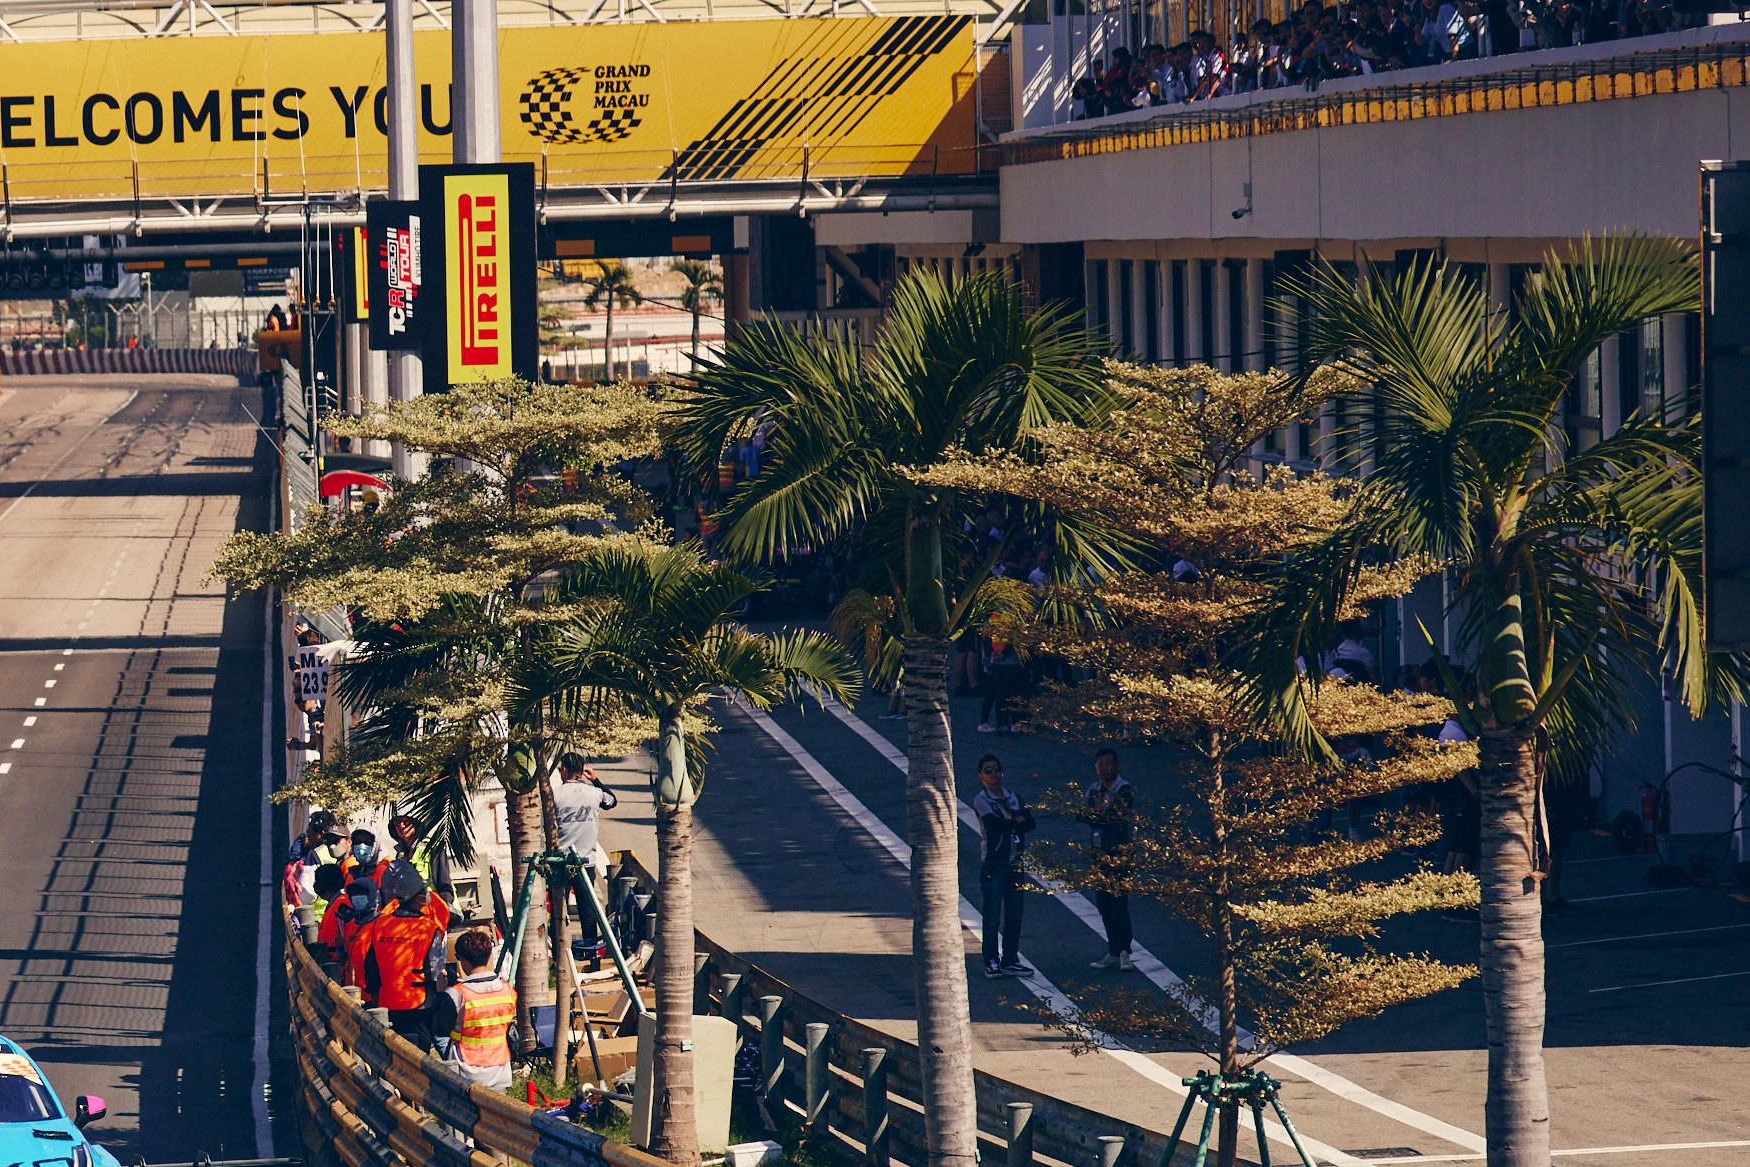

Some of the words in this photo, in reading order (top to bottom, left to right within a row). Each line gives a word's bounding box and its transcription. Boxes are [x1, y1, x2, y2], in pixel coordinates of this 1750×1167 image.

[595, 64, 650, 78] GRAND
[595, 80, 631, 93] PRIX
[594, 94, 649, 108] MACAU
[458, 194, 498, 365] PIRELLI
[389, 287, 406, 335] TCR
